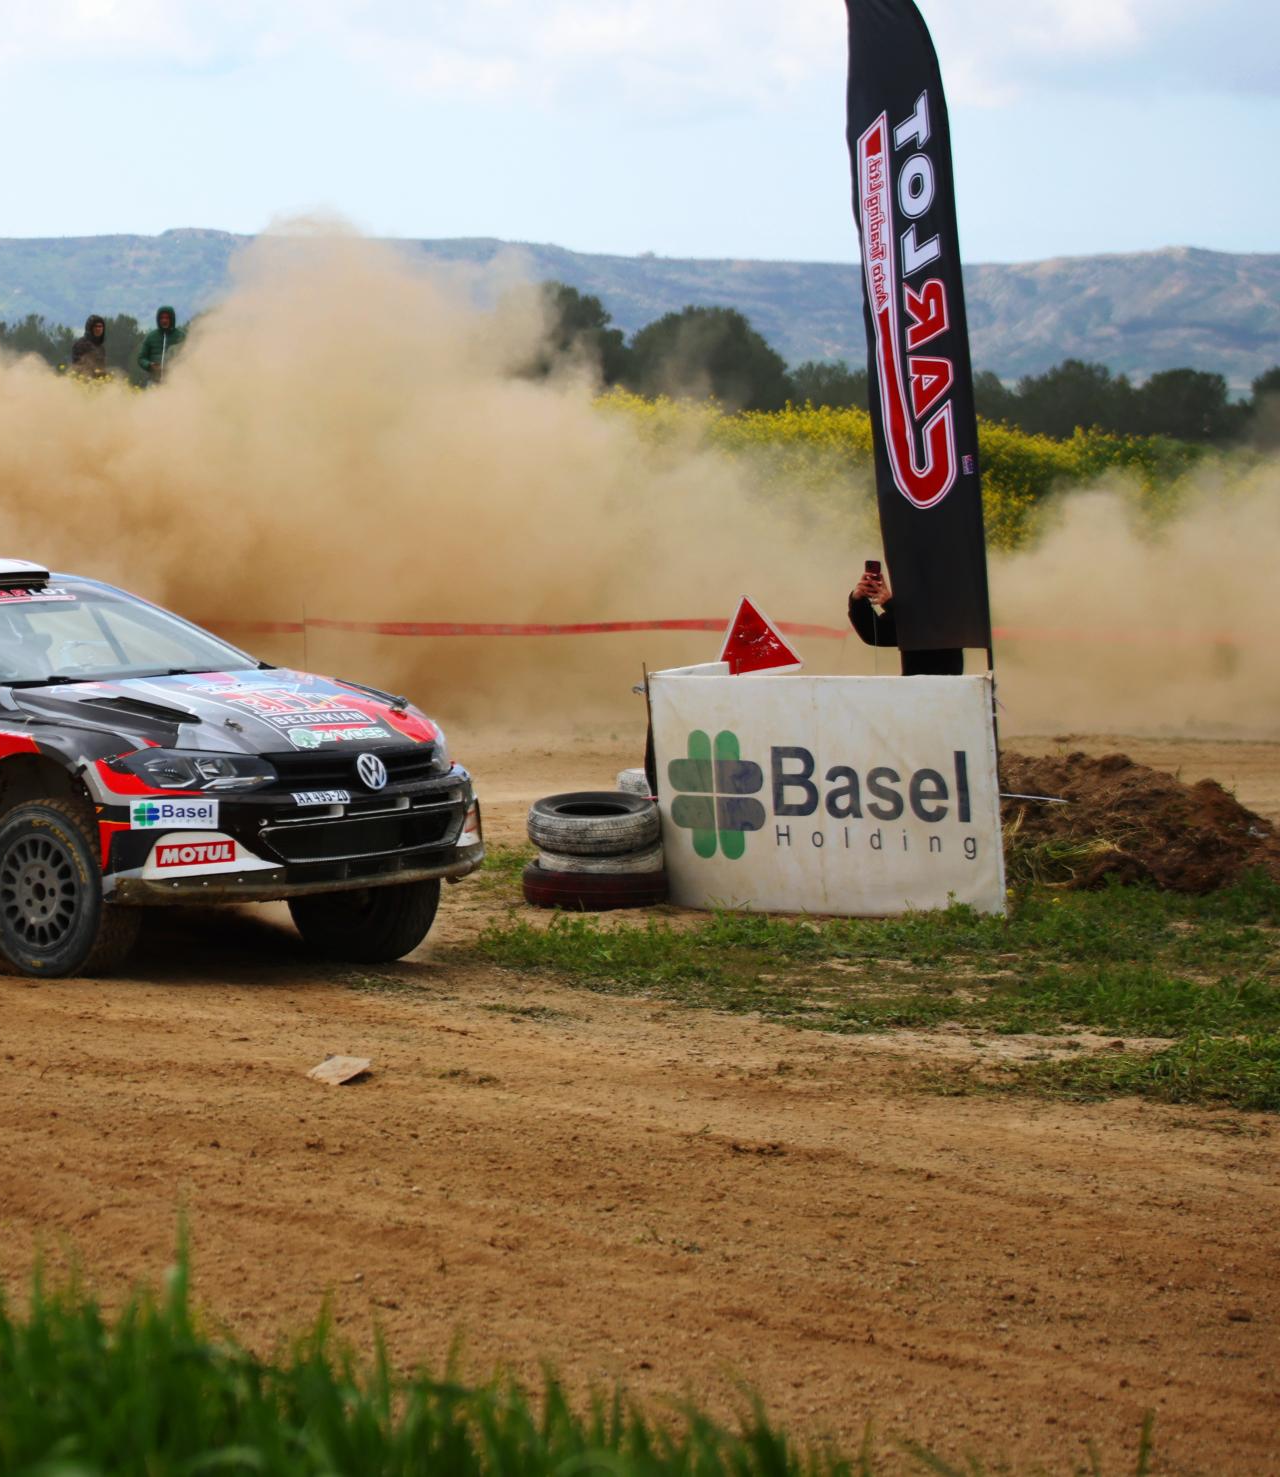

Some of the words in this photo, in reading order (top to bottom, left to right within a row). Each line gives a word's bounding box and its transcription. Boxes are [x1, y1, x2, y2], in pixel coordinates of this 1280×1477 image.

[272, 711, 369, 725] BEZDIKIAN
[771, 746, 972, 823] Basel
[162, 804, 213, 818] Basel
[775, 825, 978, 860] Holding
[160, 844, 232, 864] MOTUL
